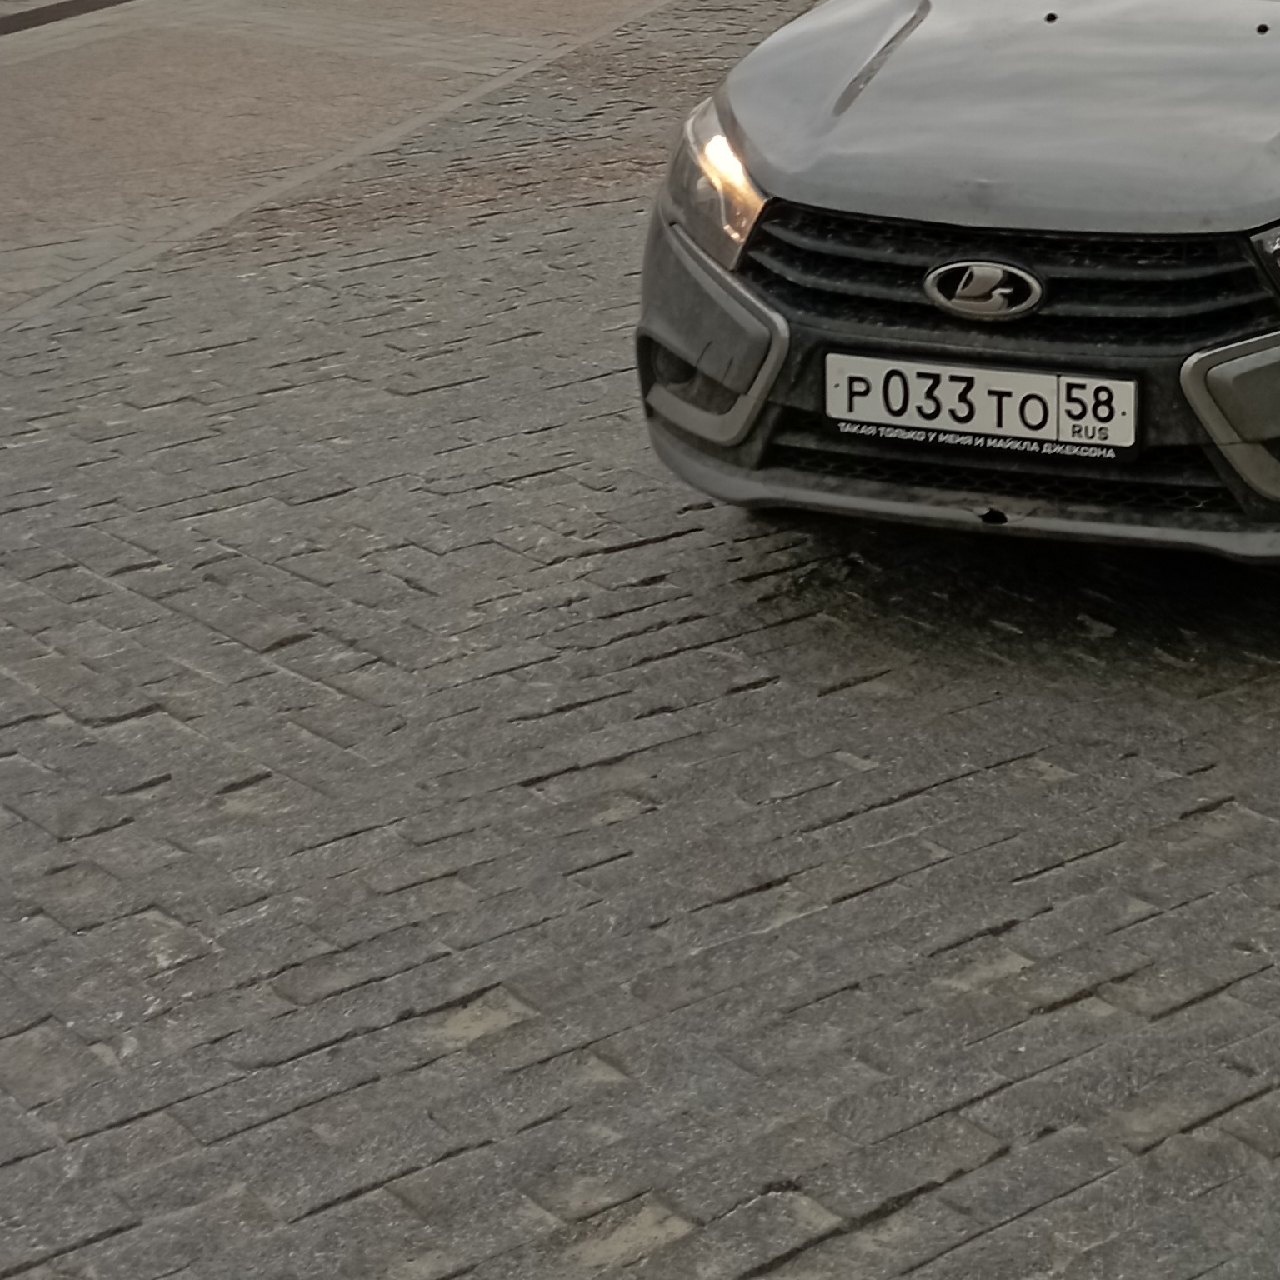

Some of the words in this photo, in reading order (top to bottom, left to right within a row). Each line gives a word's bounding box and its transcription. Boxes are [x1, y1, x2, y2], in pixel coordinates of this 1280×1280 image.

[1064, 383, 1115, 423] 58
[838, 422, 878, 437] ТАКАЯ
[878, 426, 926, 442] ТОЛЬКО
[927, 431, 938, 443] У
[938, 432, 973, 446] МЕНЯ
[973, 436, 985, 448] И
[986, 437, 1040, 452] МАЙКЛА
[1041, 442, 1116, 458] ДЖЕКСОНА
[1071, 424, 1109, 441] RUS
